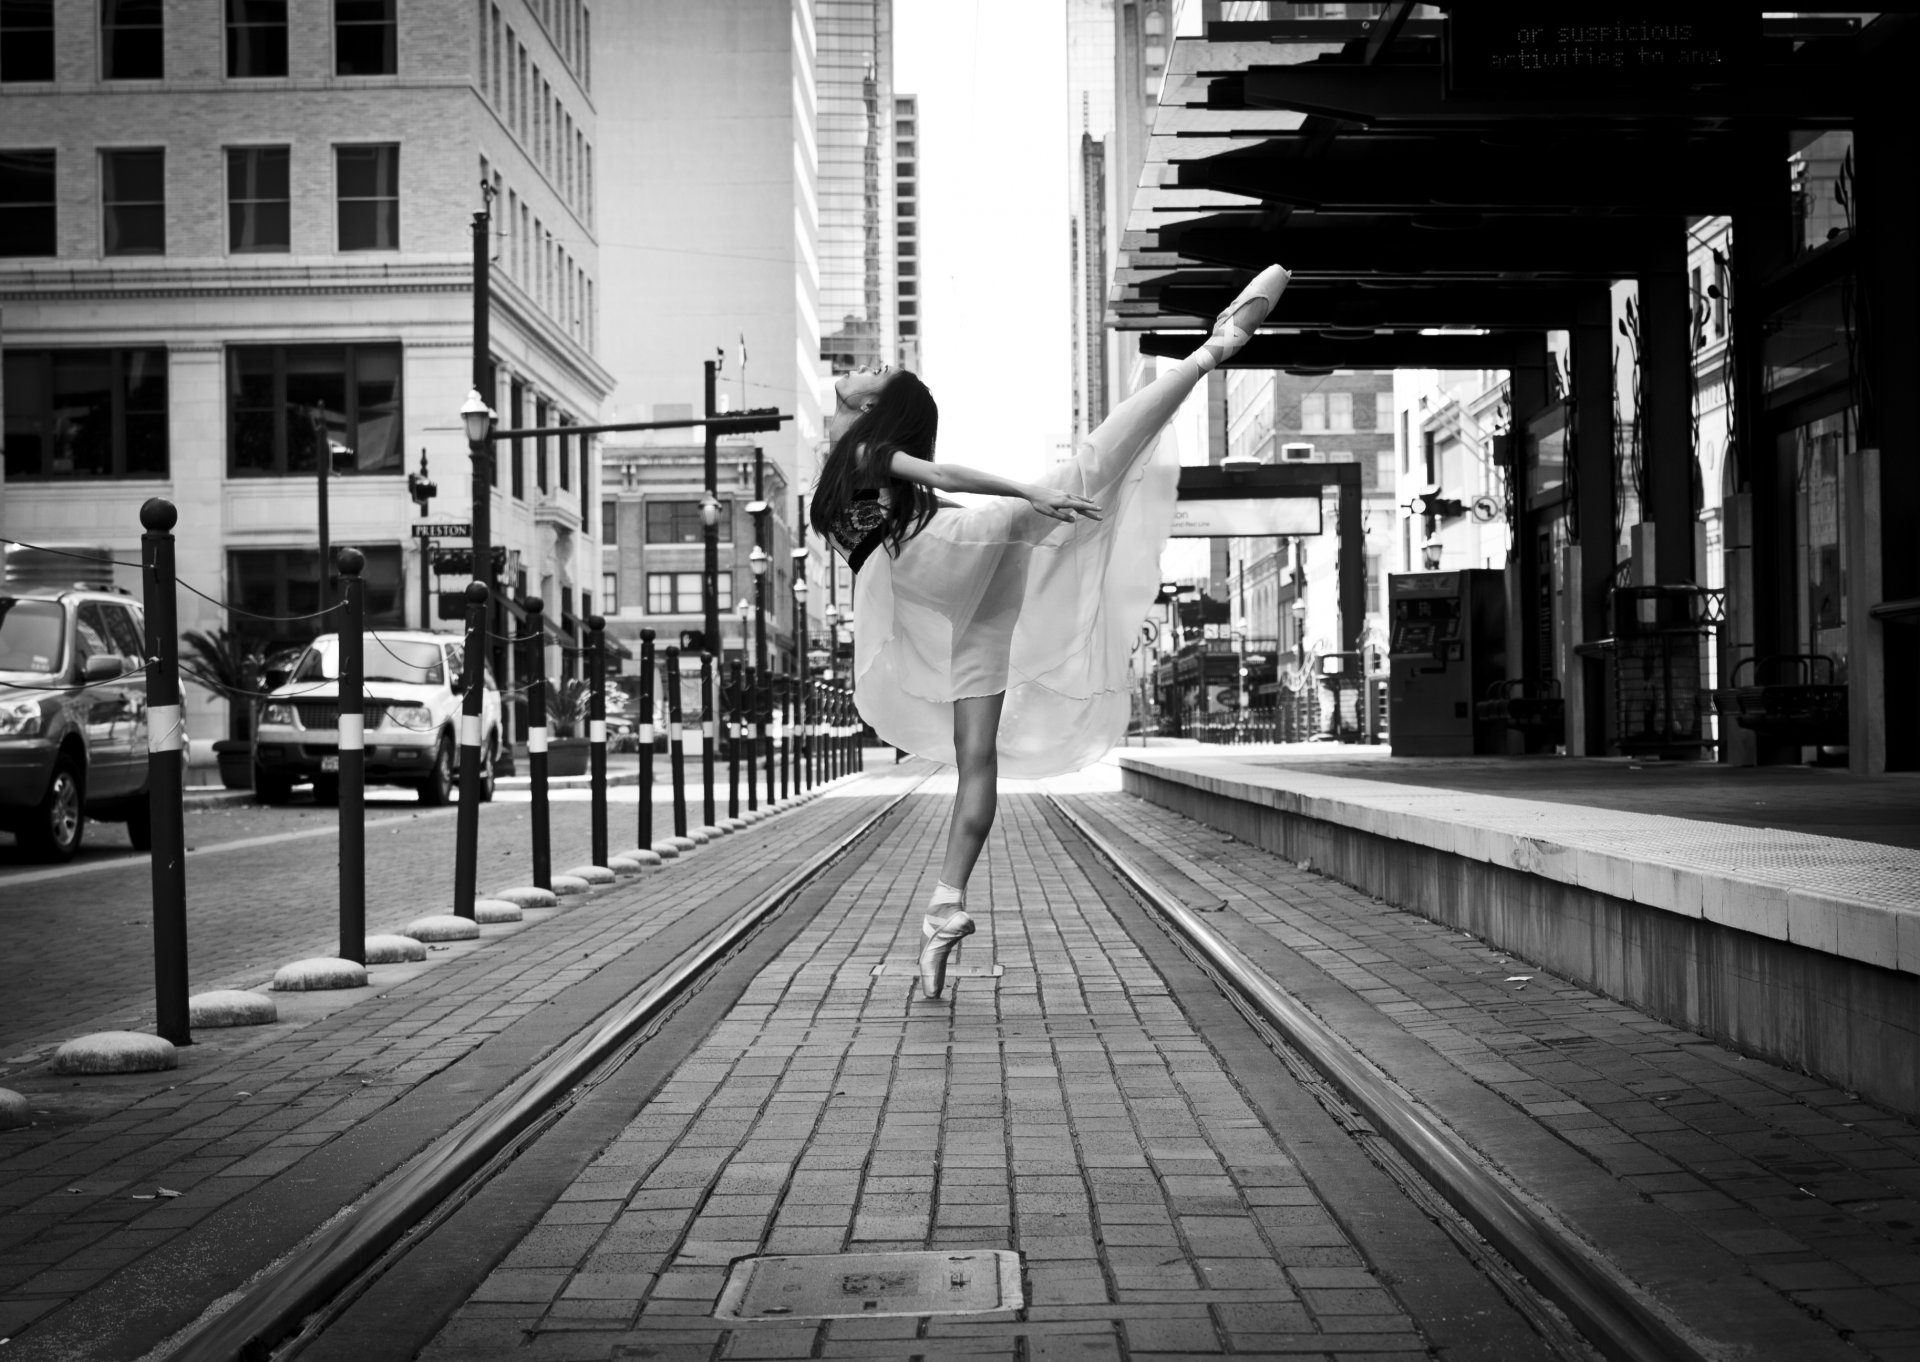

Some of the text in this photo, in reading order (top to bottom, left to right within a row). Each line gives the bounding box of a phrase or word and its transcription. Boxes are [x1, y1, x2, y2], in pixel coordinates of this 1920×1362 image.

[1517, 20, 1692, 43] or suspicious
[415, 525, 467, 536] PRESTON
